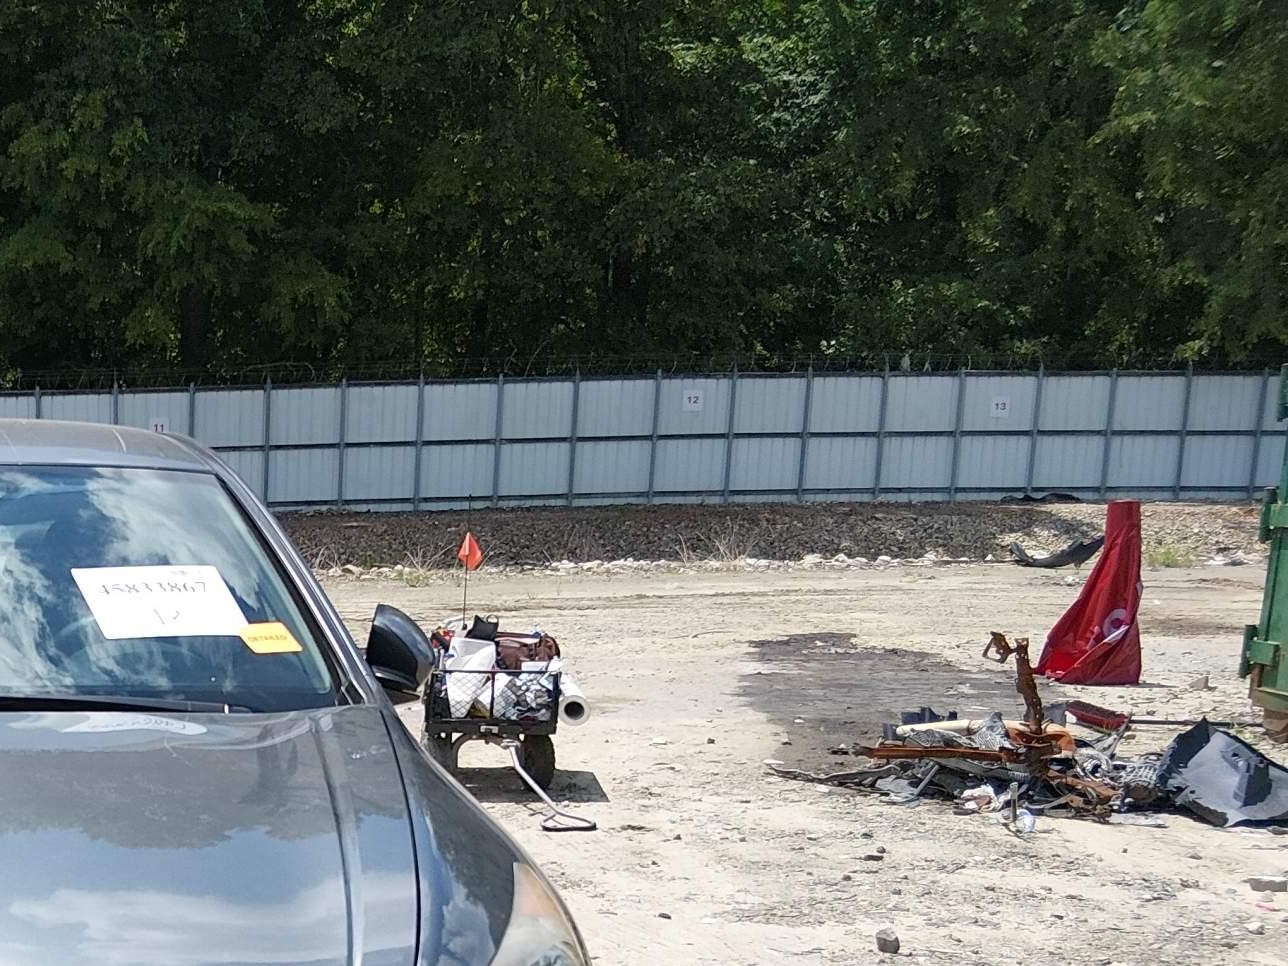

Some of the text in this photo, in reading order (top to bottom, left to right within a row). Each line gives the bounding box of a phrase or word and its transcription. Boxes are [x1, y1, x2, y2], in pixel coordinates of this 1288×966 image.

[687, 395, 700, 405] 12
[994, 402, 1007, 411] 13
[153, 423, 165, 433] 11
